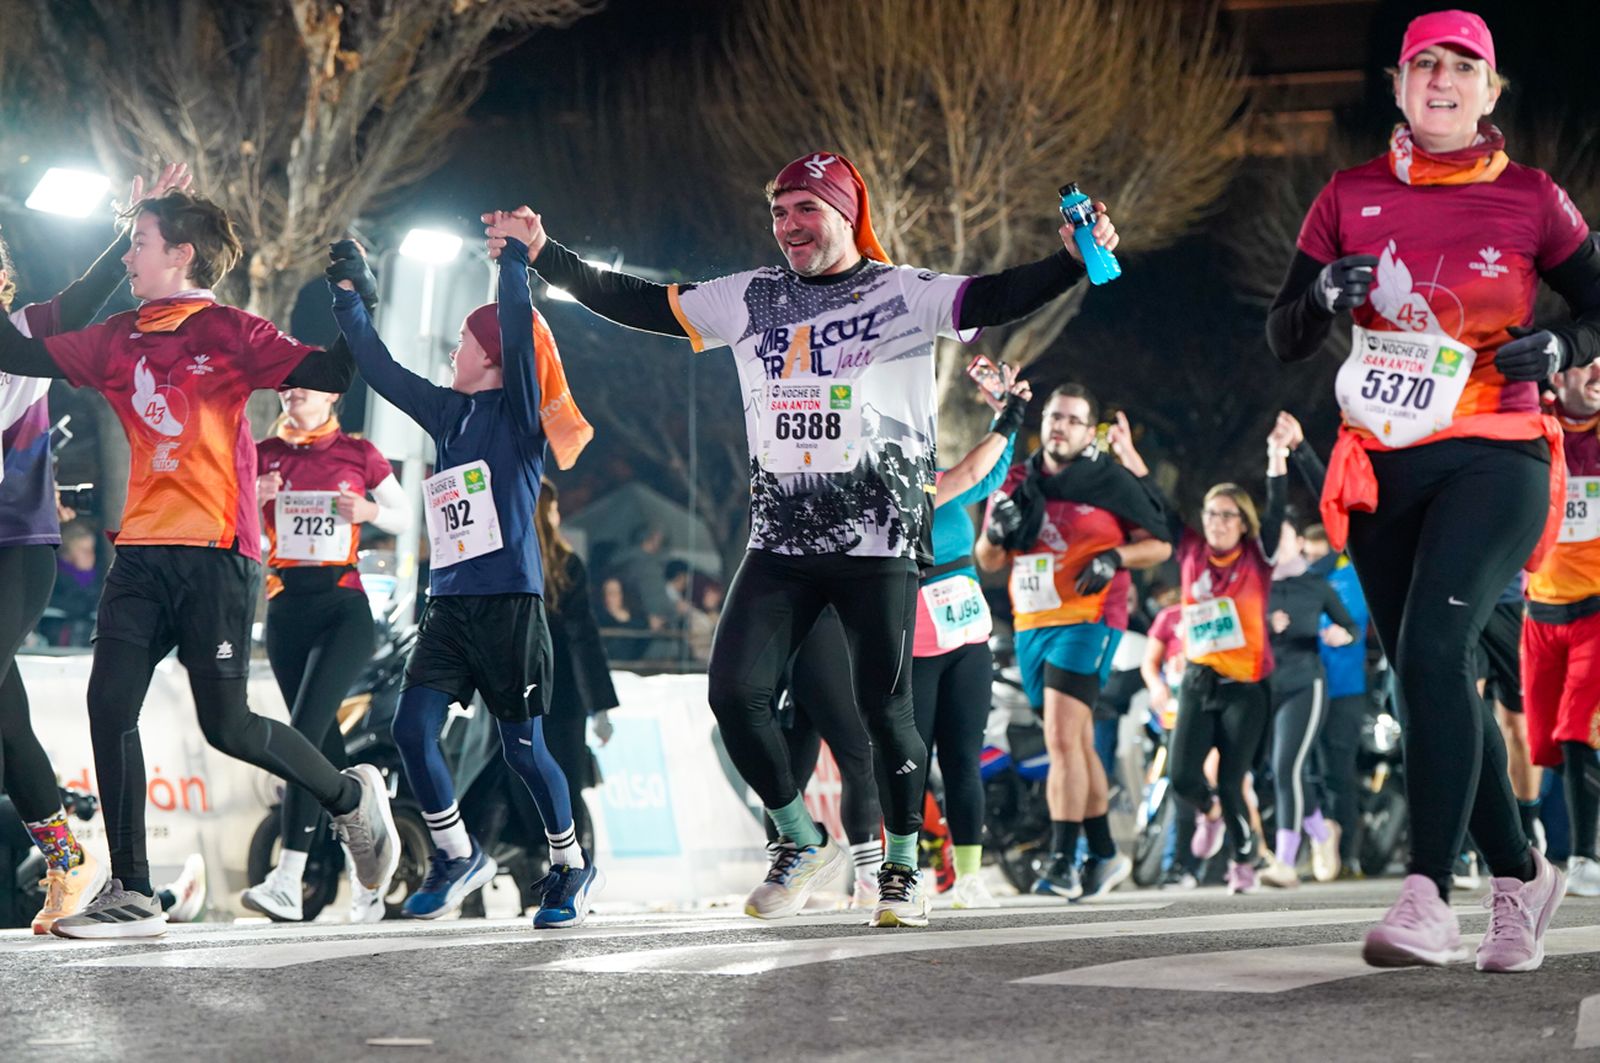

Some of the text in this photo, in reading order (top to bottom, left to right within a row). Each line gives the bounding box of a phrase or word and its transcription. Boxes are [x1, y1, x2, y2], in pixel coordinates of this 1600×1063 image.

[1396, 302, 1428, 333] 43
[1363, 354, 1386, 368] SAN
[1381, 345, 1429, 360] NOCHE DE
[781, 388, 821, 398] NOCHE DE
[1361, 369, 1436, 411] 5370
[144, 402, 165, 424] 43
[771, 400, 788, 411] SAN
[776, 412, 841, 440] 6388
[293, 516, 335, 536] 2123
